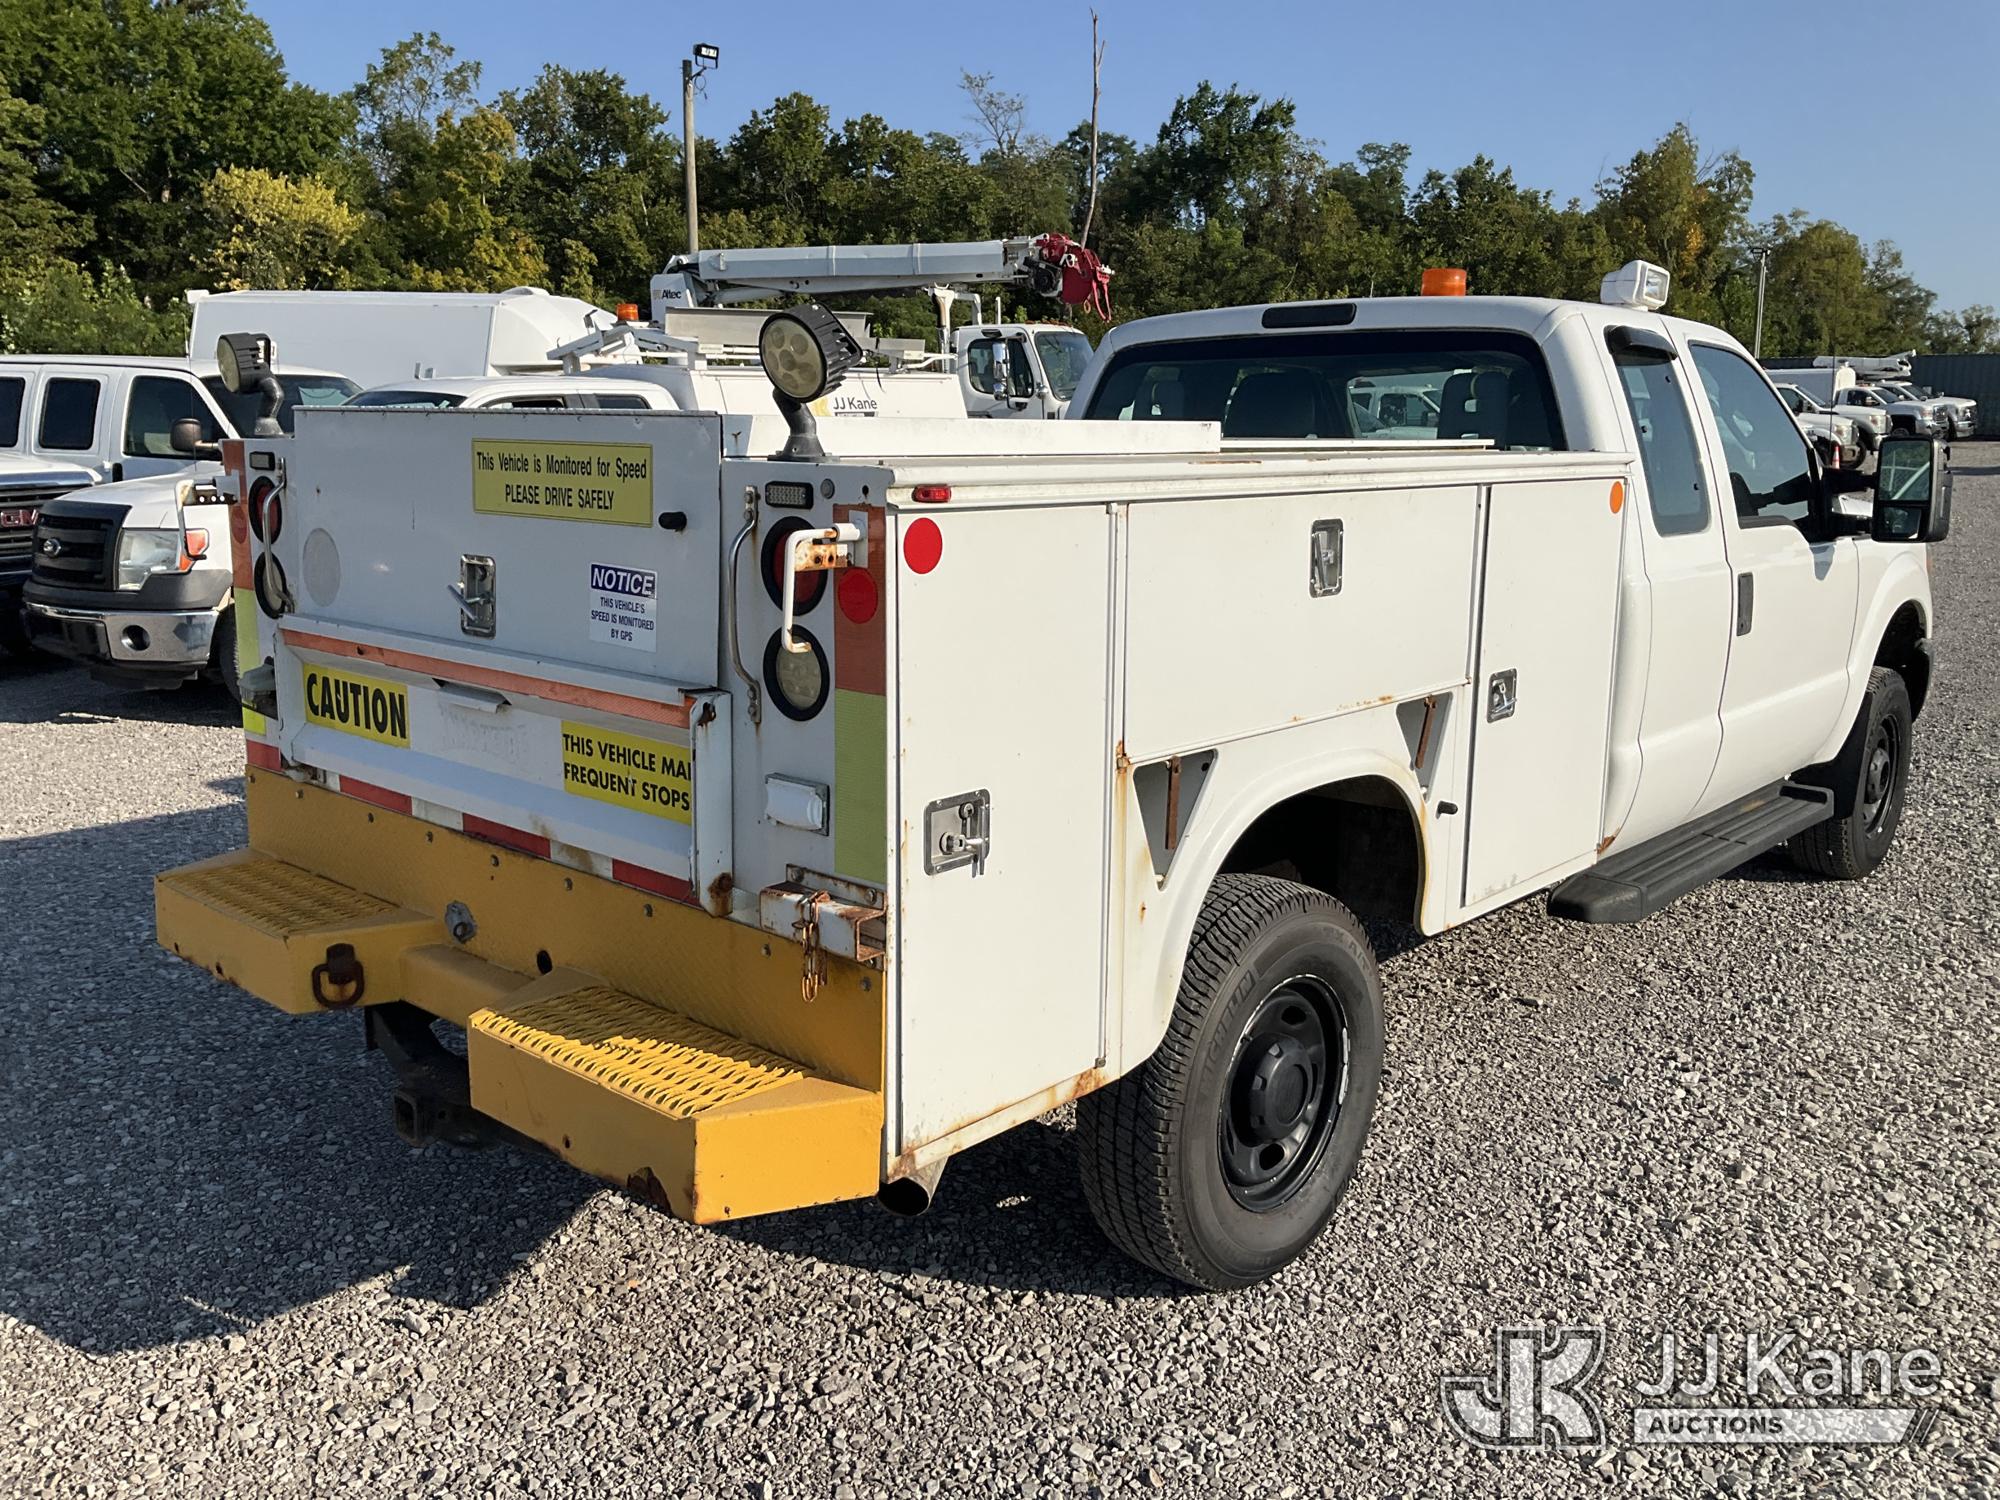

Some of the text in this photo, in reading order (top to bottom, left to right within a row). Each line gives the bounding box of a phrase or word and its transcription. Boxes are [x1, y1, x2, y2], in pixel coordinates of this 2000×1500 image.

[662, 289, 682, 299] Altec
[833, 397, 878, 410] JJ Kane
[477, 452, 647, 483] This Vehicle is Monitored for Speed
[505, 484, 614, 510] PLEASE DRIVE SAFELY
[592, 567, 654, 595] NOTICE
[600, 597, 614, 608] THIS
[591, 610, 655, 631] SPEED IS MONITORED
[610, 628, 633, 641] BY GPS
[306, 673, 407, 739] CAUTION
[563, 733, 594, 757] THIS
[597, 741, 656, 772] VEHICLE
[563, 762, 690, 811] FREQUENT STOPS
